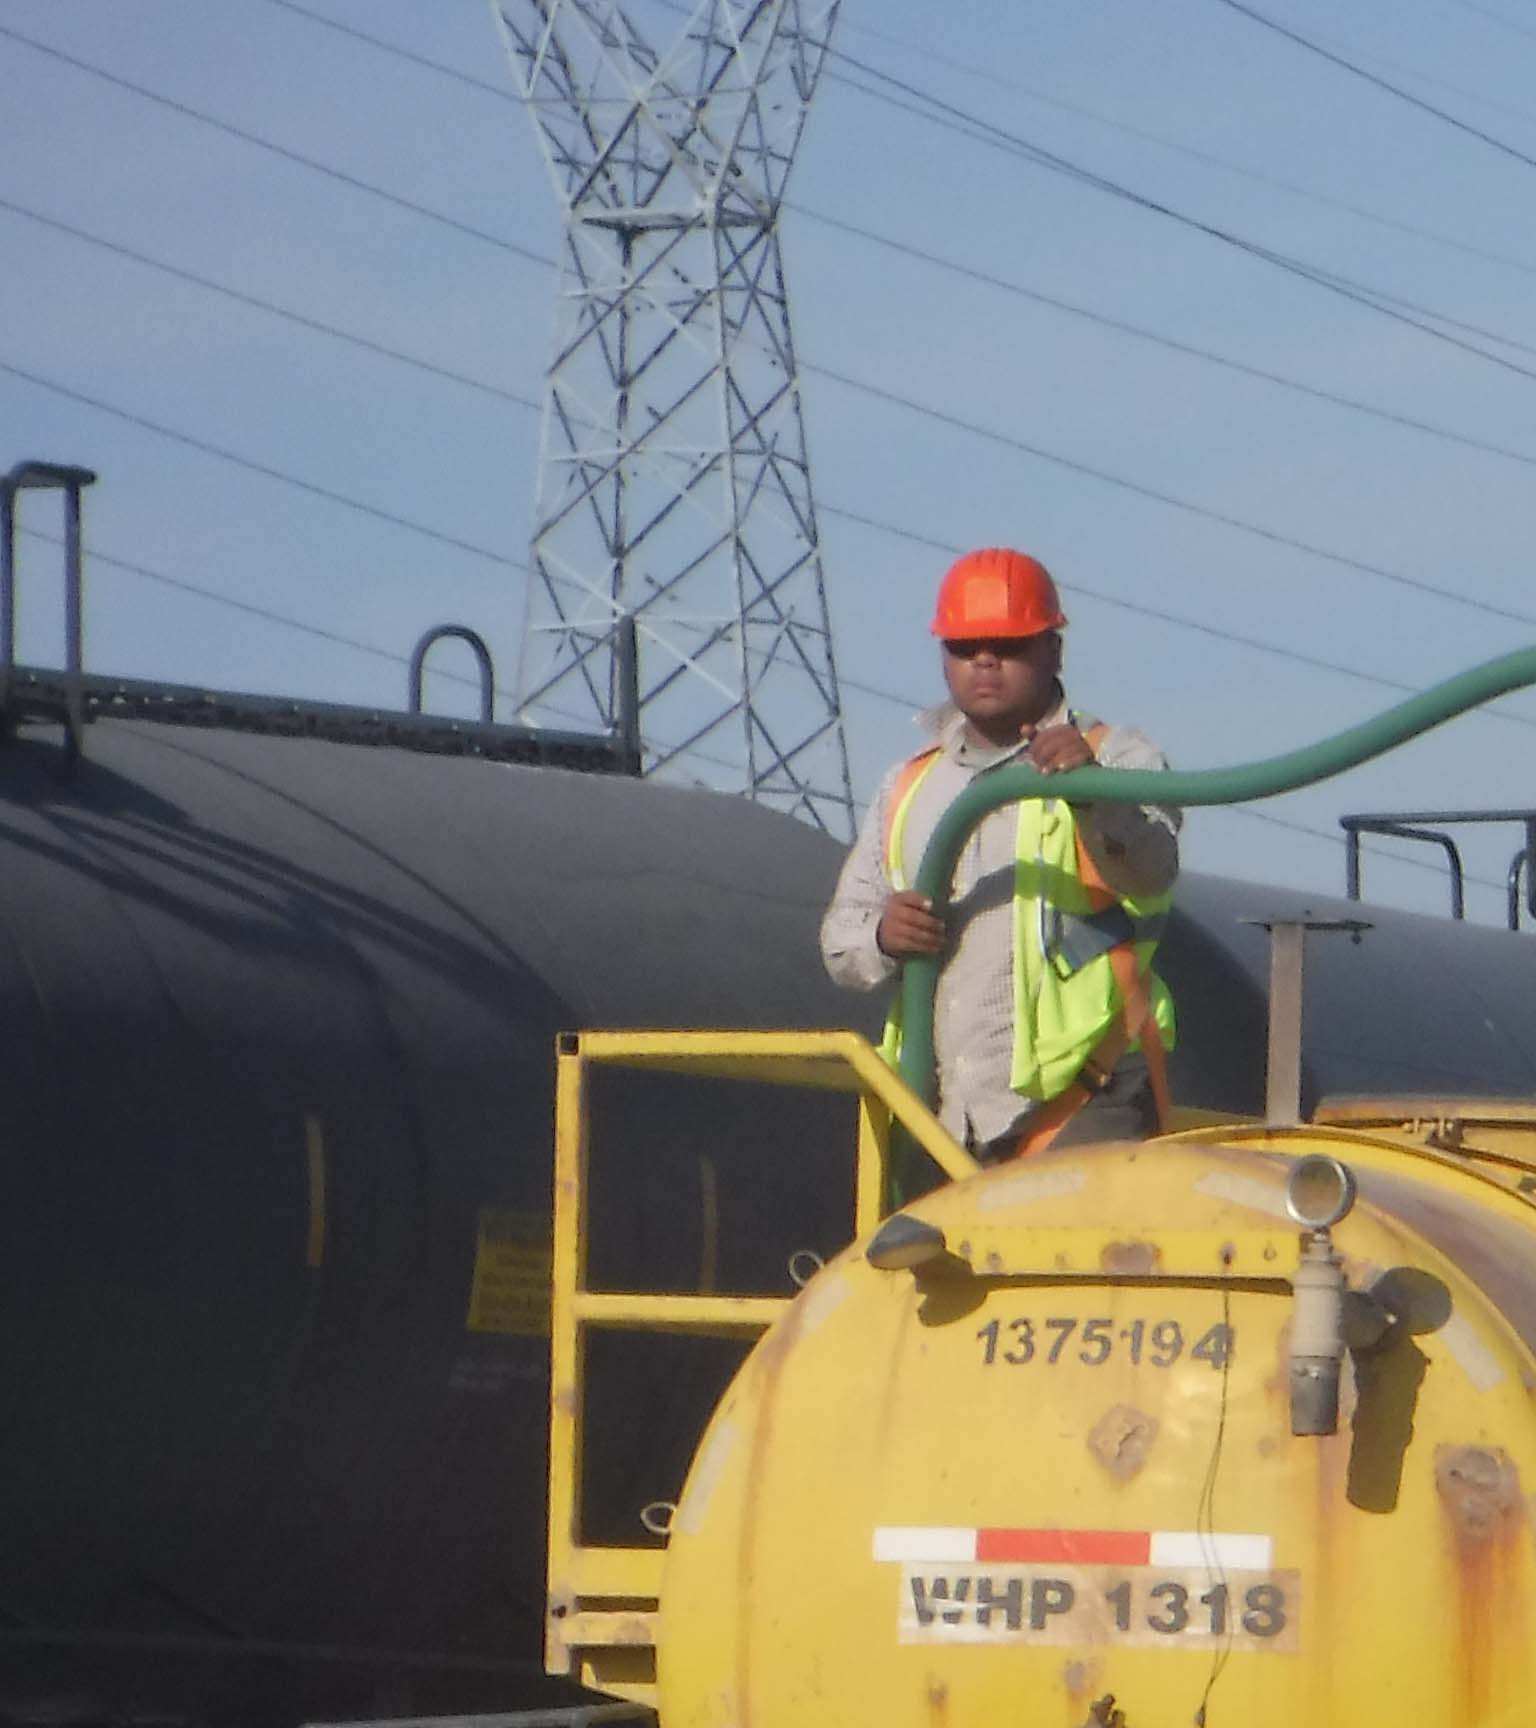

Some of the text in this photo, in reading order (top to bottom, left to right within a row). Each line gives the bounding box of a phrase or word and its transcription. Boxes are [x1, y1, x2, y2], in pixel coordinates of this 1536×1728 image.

[976, 1317, 1236, 1370] 1375194
[911, 1576, 1286, 1637] WHP 1318
